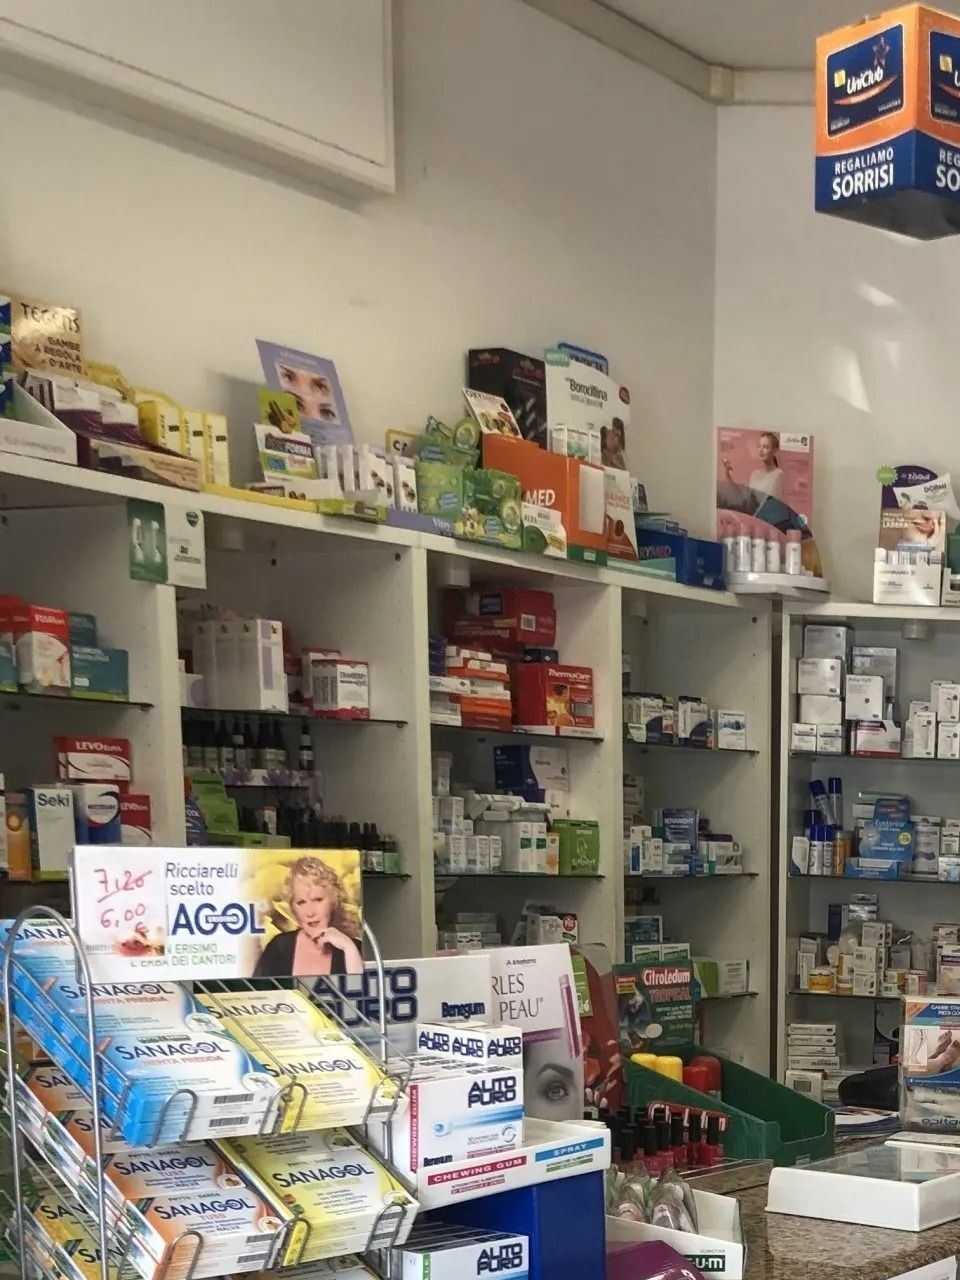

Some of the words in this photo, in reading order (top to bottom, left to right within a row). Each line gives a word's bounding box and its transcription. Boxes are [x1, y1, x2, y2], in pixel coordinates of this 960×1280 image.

[846, 66, 884, 95] UniClub
[834, 147, 894, 175] REGALIAMO
[832, 163, 894, 201] SORRISI
[37, 791, 71, 808] Seki
[165, 862, 239, 879] Ricciarelli
[170, 881, 215, 896] scelto
[441, 1001, 486, 1020] Benegum
[115, 1041, 231, 1060] SANAGOL
[553, 1143, 587, 1156] SPRAY
[114, 1156, 216, 1176] SANAGOL
[272, 1163, 375, 1188] SANAGOL
[434, 1165, 492, 1182] CHEWING
[497, 1157, 523, 1168] GUM
[154, 1199, 256, 1220] SANAGOL
